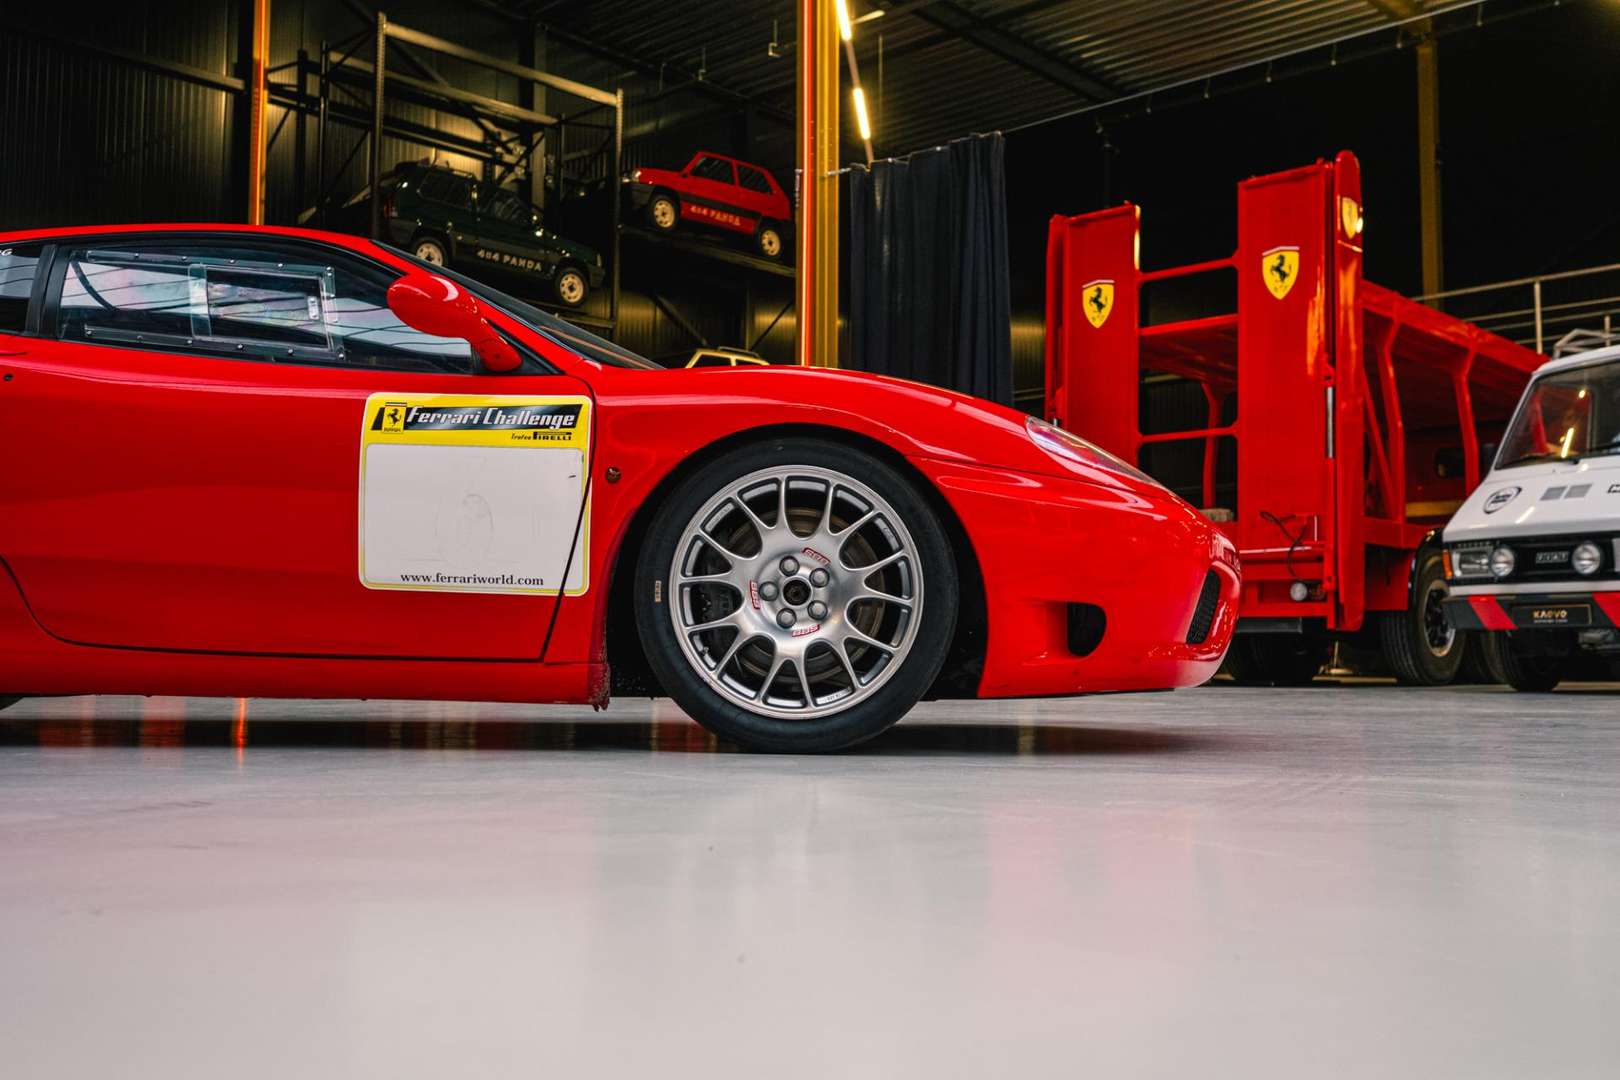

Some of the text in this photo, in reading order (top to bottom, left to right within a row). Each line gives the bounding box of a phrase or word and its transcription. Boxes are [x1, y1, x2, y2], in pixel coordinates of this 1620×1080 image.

[503, 254, 542, 271] PANDA
[407, 406, 575, 429] Ferrari Challenge
[533, 432, 572, 441] PIRELLI
[400, 572, 544, 586] www.ferrariworld.com
